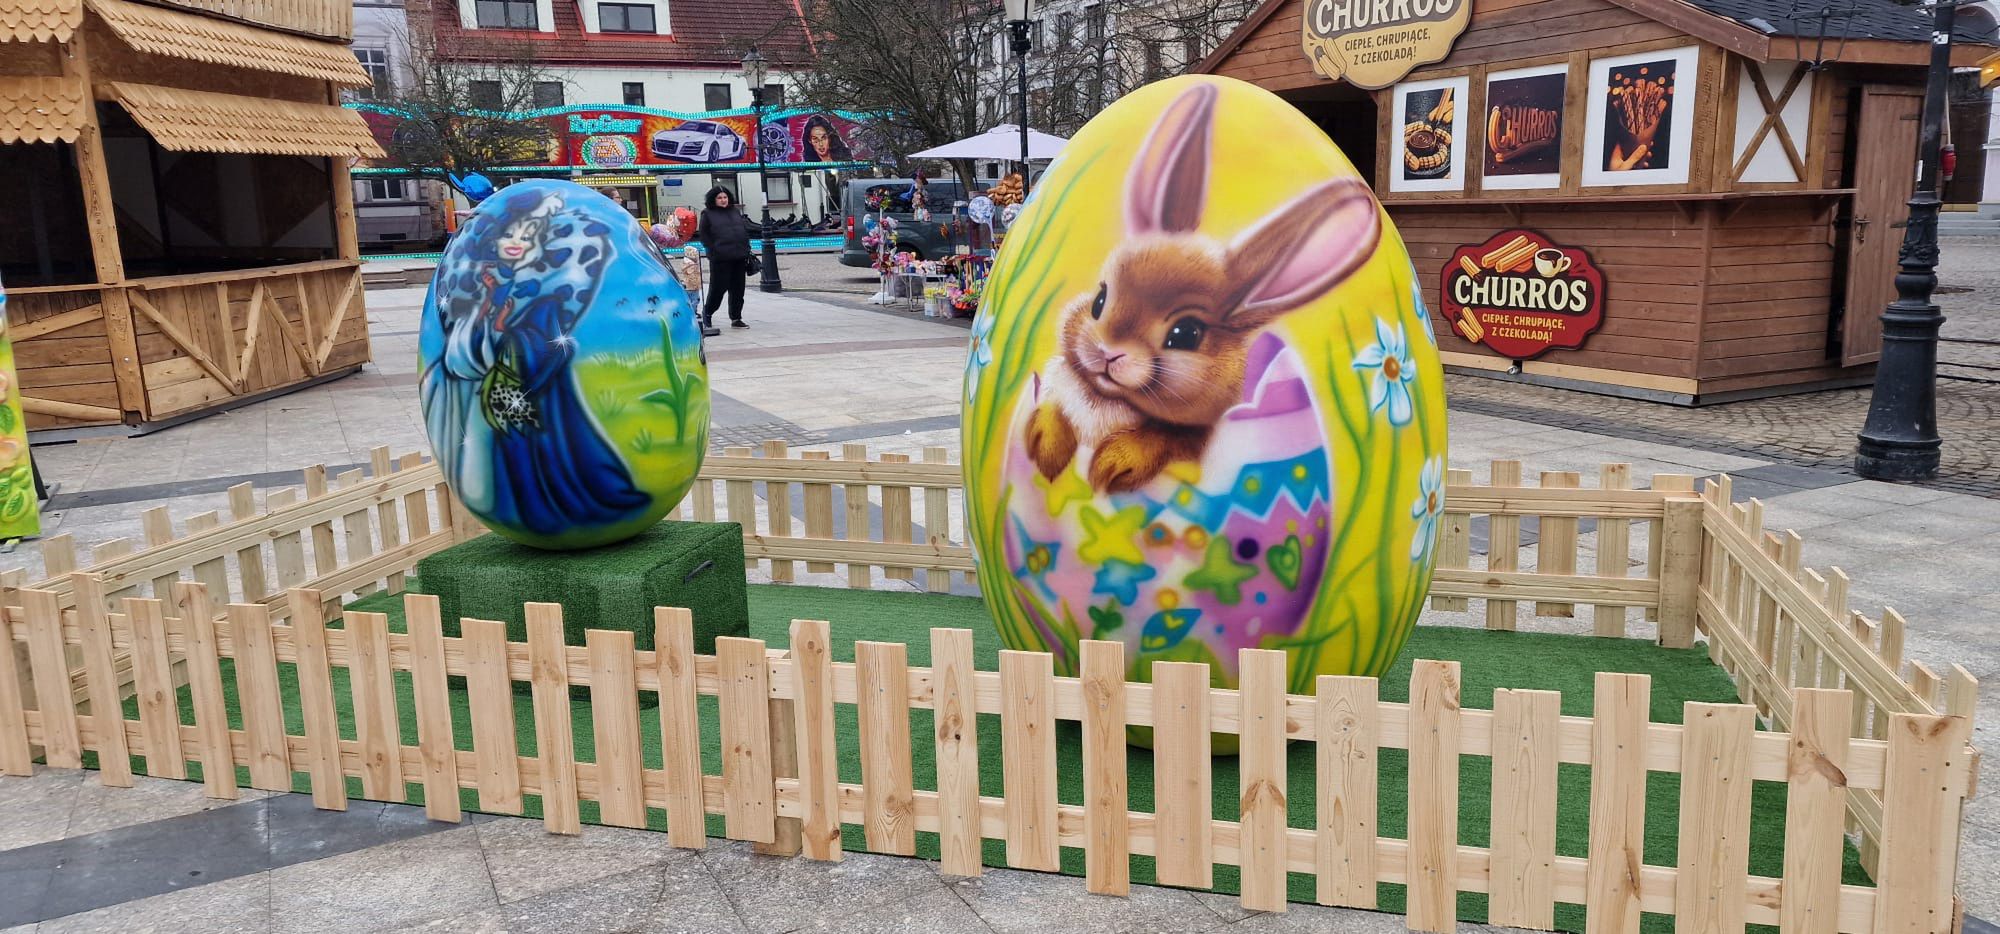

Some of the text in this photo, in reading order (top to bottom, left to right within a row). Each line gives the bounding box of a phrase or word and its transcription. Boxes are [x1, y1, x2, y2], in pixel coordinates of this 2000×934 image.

[1345, 28, 1431, 52] CIEPŁE, CHRUPIĄCE,
[1353, 46, 1417, 65] Z CZEKOLADĄ!
[1489, 106, 1557, 151] CHURROS
[1454, 274, 1587, 312] CHURROS
[1482, 313, 1566, 331] CIEPŁE, CHRUPIĄCE,
[1491, 327, 1553, 343] Z CZEKOLADĄ!
